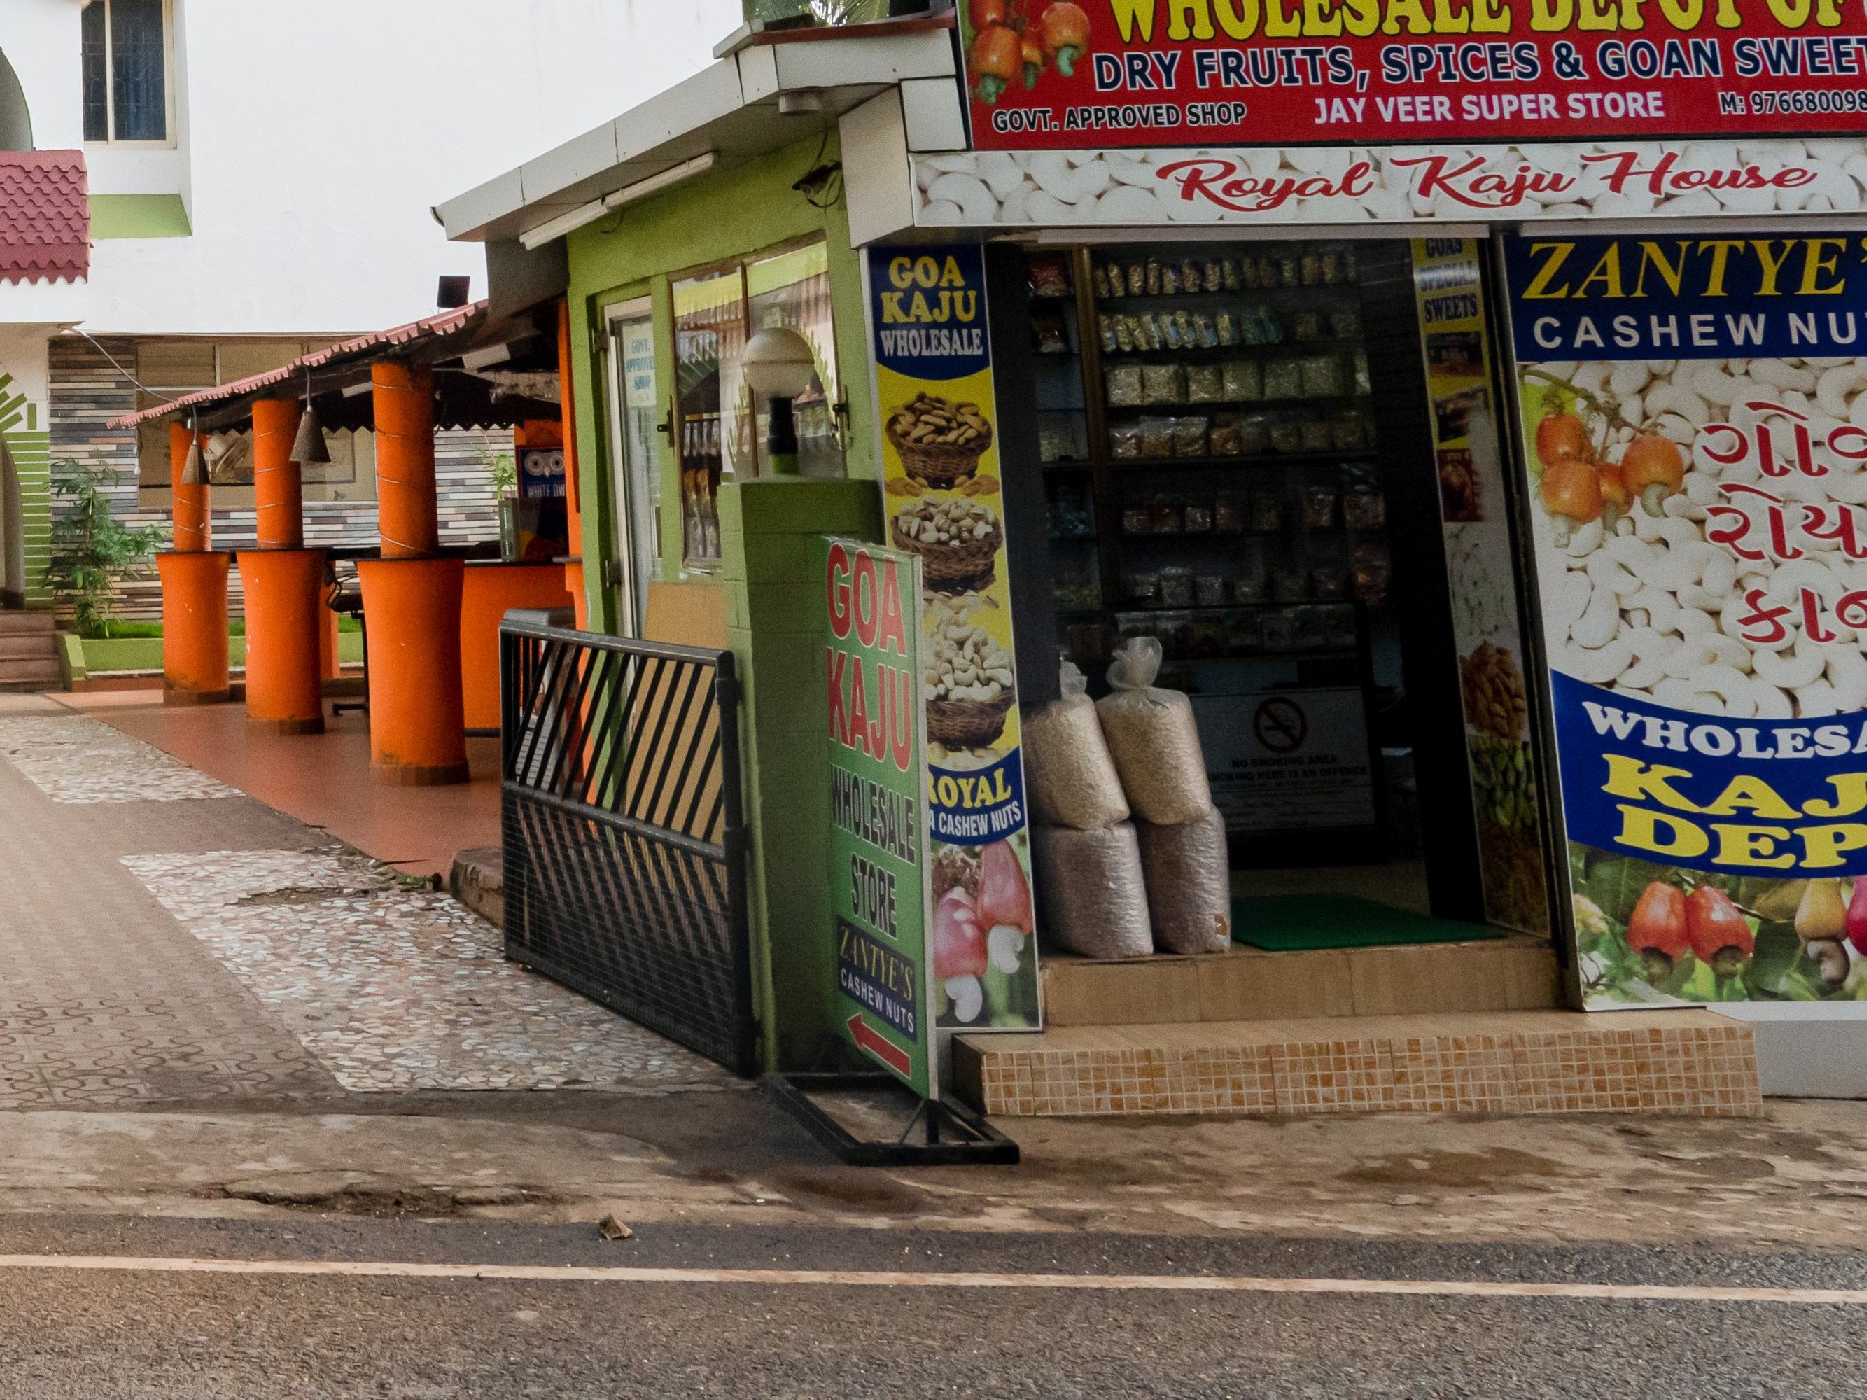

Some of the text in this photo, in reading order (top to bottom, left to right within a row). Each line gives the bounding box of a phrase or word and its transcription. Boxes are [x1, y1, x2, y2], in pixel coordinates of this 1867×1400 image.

[1093, 51, 1183, 92] DRY
[1194, 46, 1370, 94] FRUITS,
[1382, 42, 1538, 85] SPICES
[1553, 42, 1588, 83] &
[1597, 38, 1723, 81] GOAN
[991, 100, 1248, 134] GOVT. APPROVED SHOP
[1313, 90, 1666, 126] JAY VEER SUPER STORE
[1718, 91, 1747, 115] M:
[1156, 151, 1820, 213] Royal Kaju House
[889, 256, 966, 288] GOA
[880, 290, 977, 323] KAJU
[1423, 293, 1478, 323] SWEETS
[880, 329, 983, 357] WHOLESALE
[1534, 311, 1867, 349] CASHEW NU
[553, 484, 566, 497] OW
[826, 542, 908, 657] GOA
[827, 646, 912, 772] KAJU
[1208, 771, 1254, 783] MOKING
[1601, 753, 1867, 819] KAJ
[832, 764, 916, 866] WHOLESALE
[938, 811, 989, 837] CASHEW
[990, 800, 1022, 832] NUTS
[1613, 804, 1867, 869] DEP
[851, 853, 897, 940] STORE
[839, 926, 913, 1001] ZANTYE'S
[840, 968, 915, 1034] CASHEW NUTS
